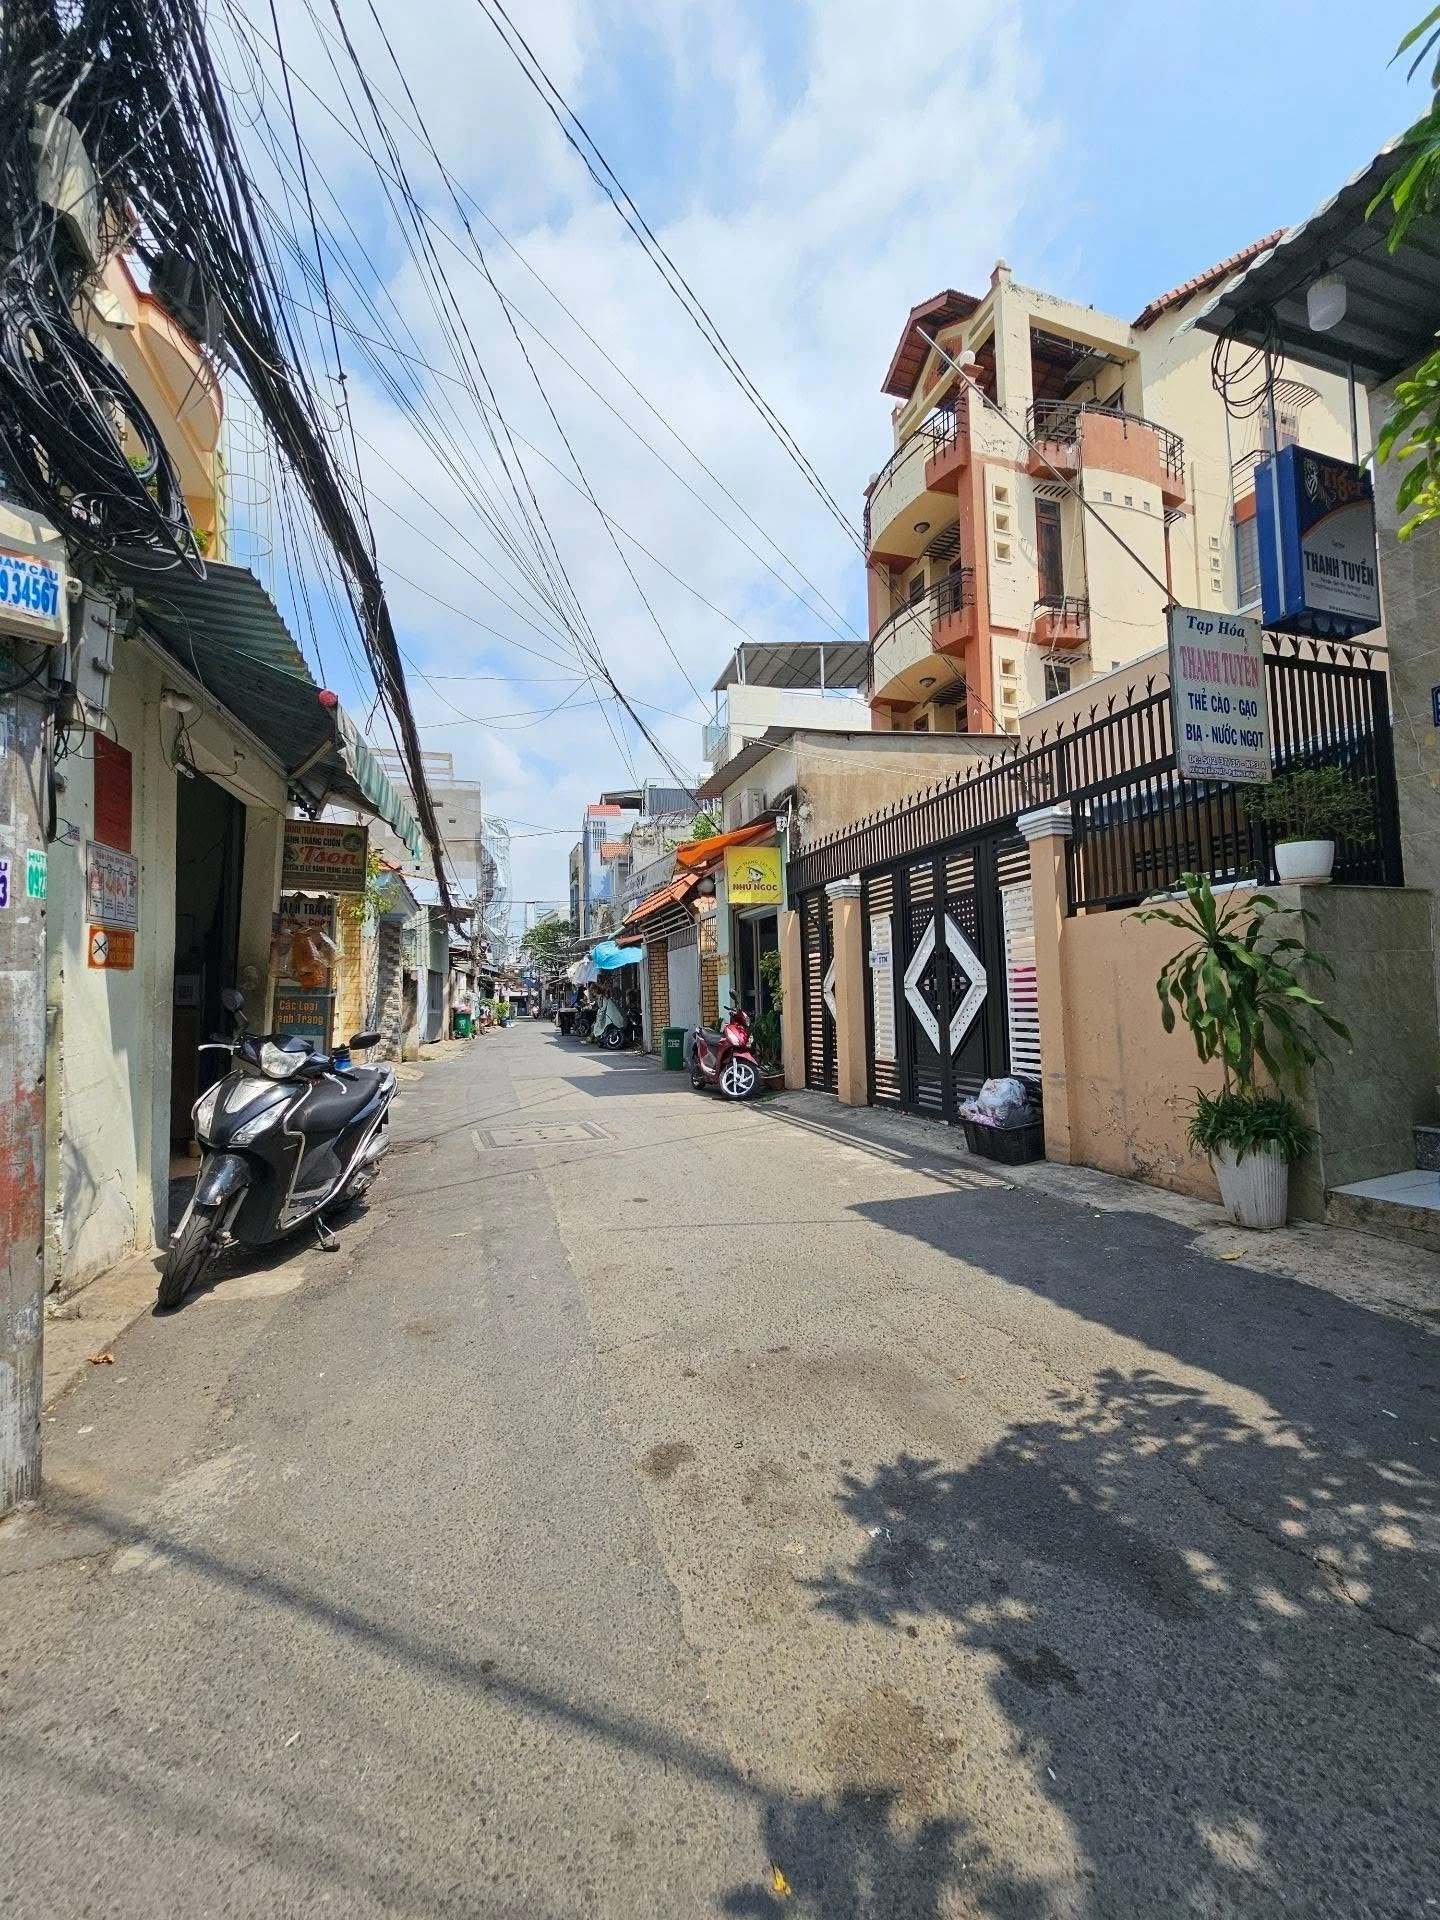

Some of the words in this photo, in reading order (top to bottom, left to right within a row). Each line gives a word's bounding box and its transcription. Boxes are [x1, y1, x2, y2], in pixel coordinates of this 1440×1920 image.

[1304, 551, 1340, 578] THANH
[12, 573, 59, 615] 34567
[1187, 616, 1213, 635] Tạp
[1218, 621, 1245, 637] Hóa
[1180, 645, 1221, 683] THANH
[1188, 688, 1207, 711] THẺ
[1211, 692, 1230, 714] CÀO
[1239, 699, 1257, 720] GẠO
[1186, 724, 1202, 741] BIA
[1211, 723, 1237, 745] NƯỚC
[1240, 729, 1263, 751] NGỌT
